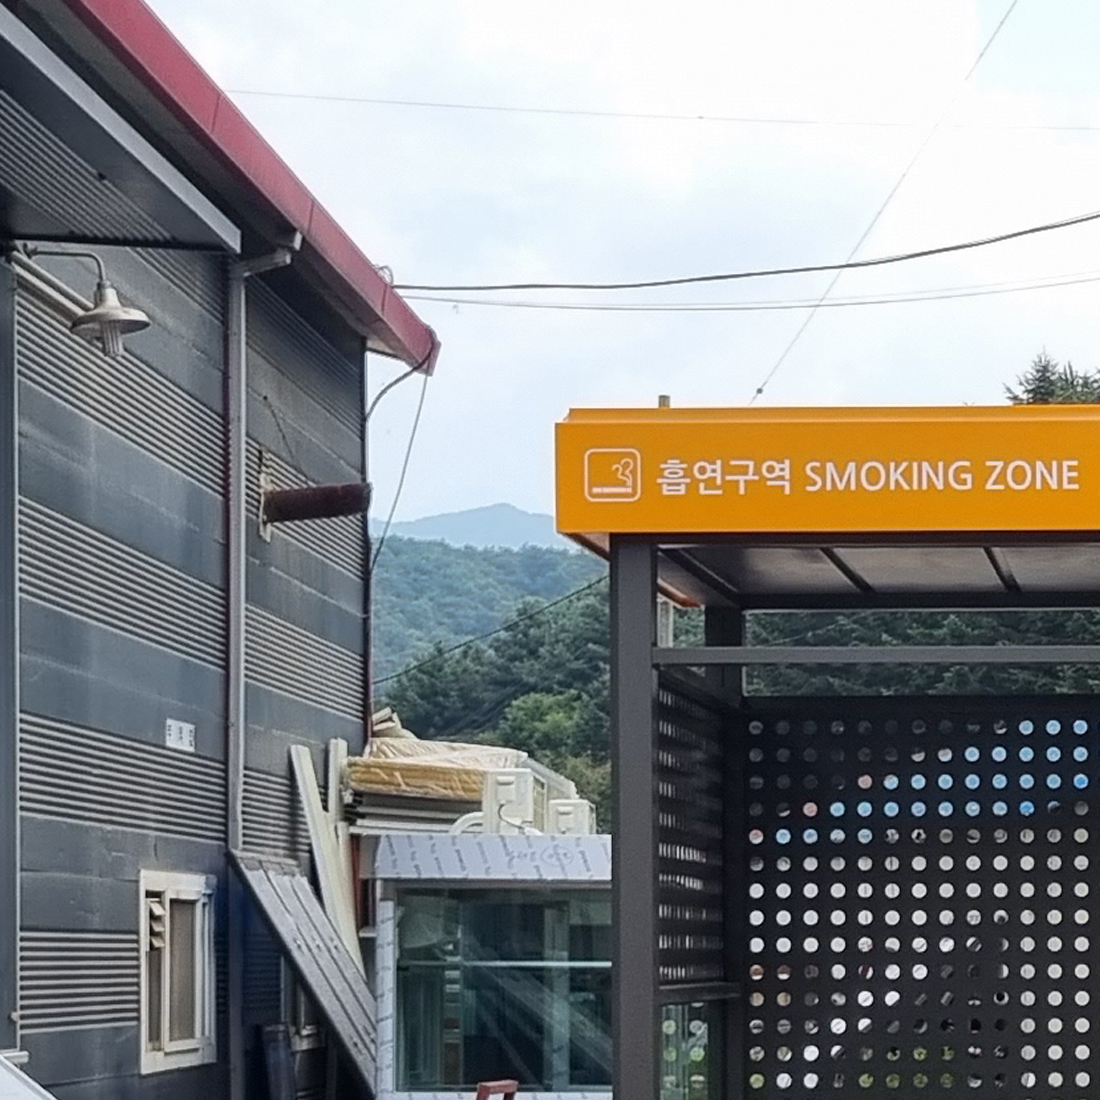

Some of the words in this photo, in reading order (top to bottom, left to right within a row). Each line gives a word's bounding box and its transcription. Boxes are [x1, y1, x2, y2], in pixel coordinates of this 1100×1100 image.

[656, 458, 791, 495] 흡연구역
[805, 460, 973, 492] SMOKING
[985, 459, 1080, 490] ZONE
